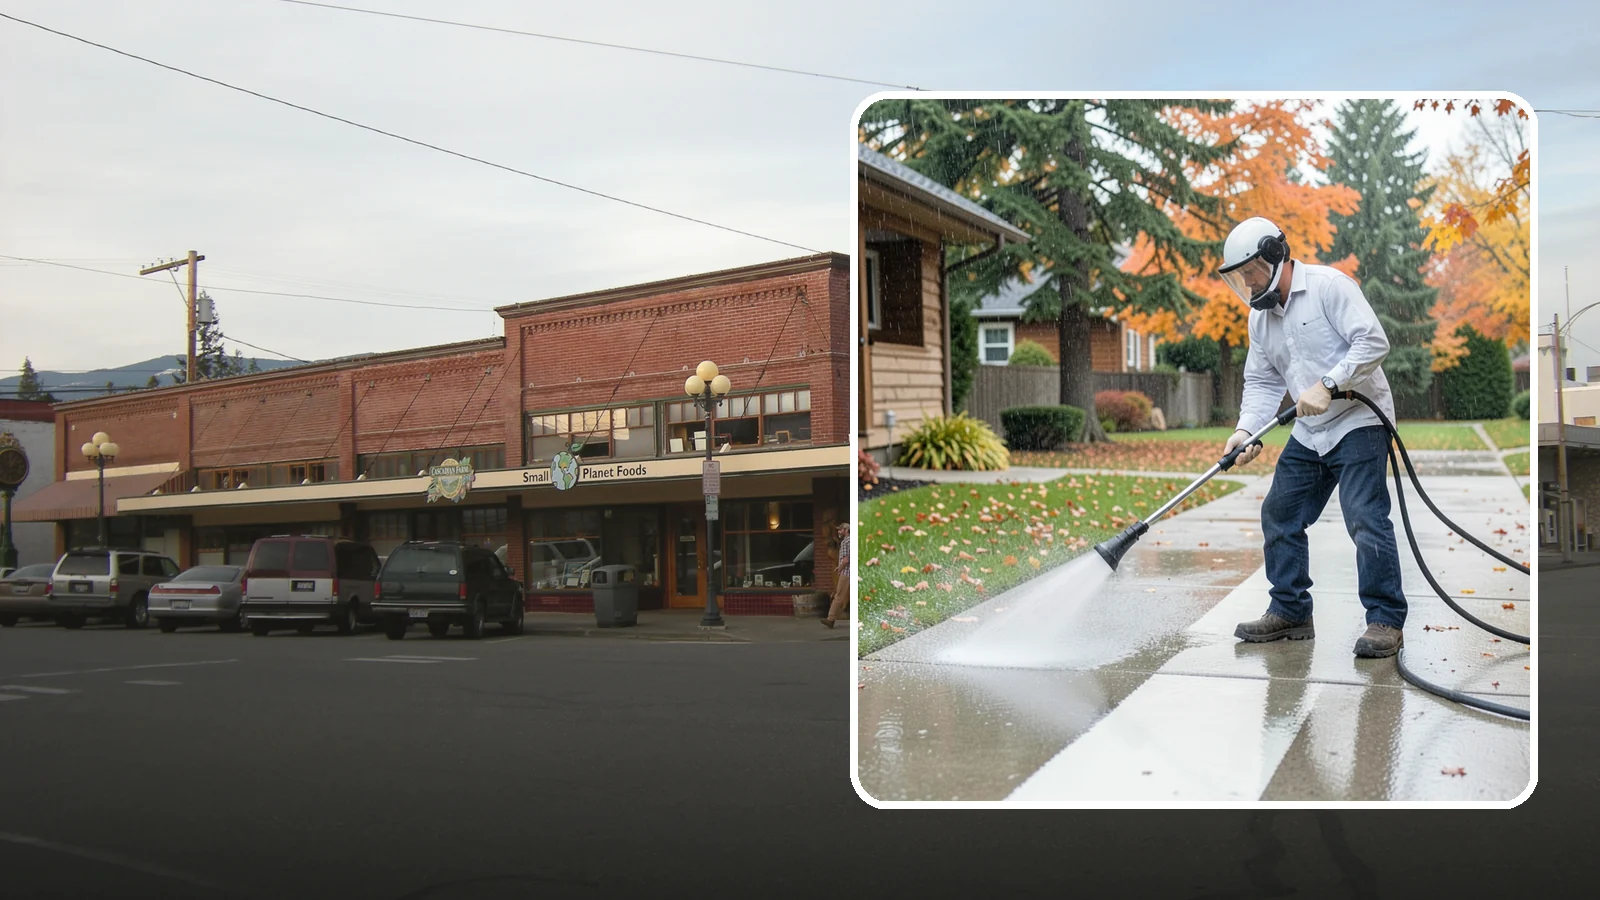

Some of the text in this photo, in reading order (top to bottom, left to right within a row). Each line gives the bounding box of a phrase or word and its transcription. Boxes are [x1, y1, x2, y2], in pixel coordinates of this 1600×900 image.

[523, 464, 647, 483] Small Planet Foods
